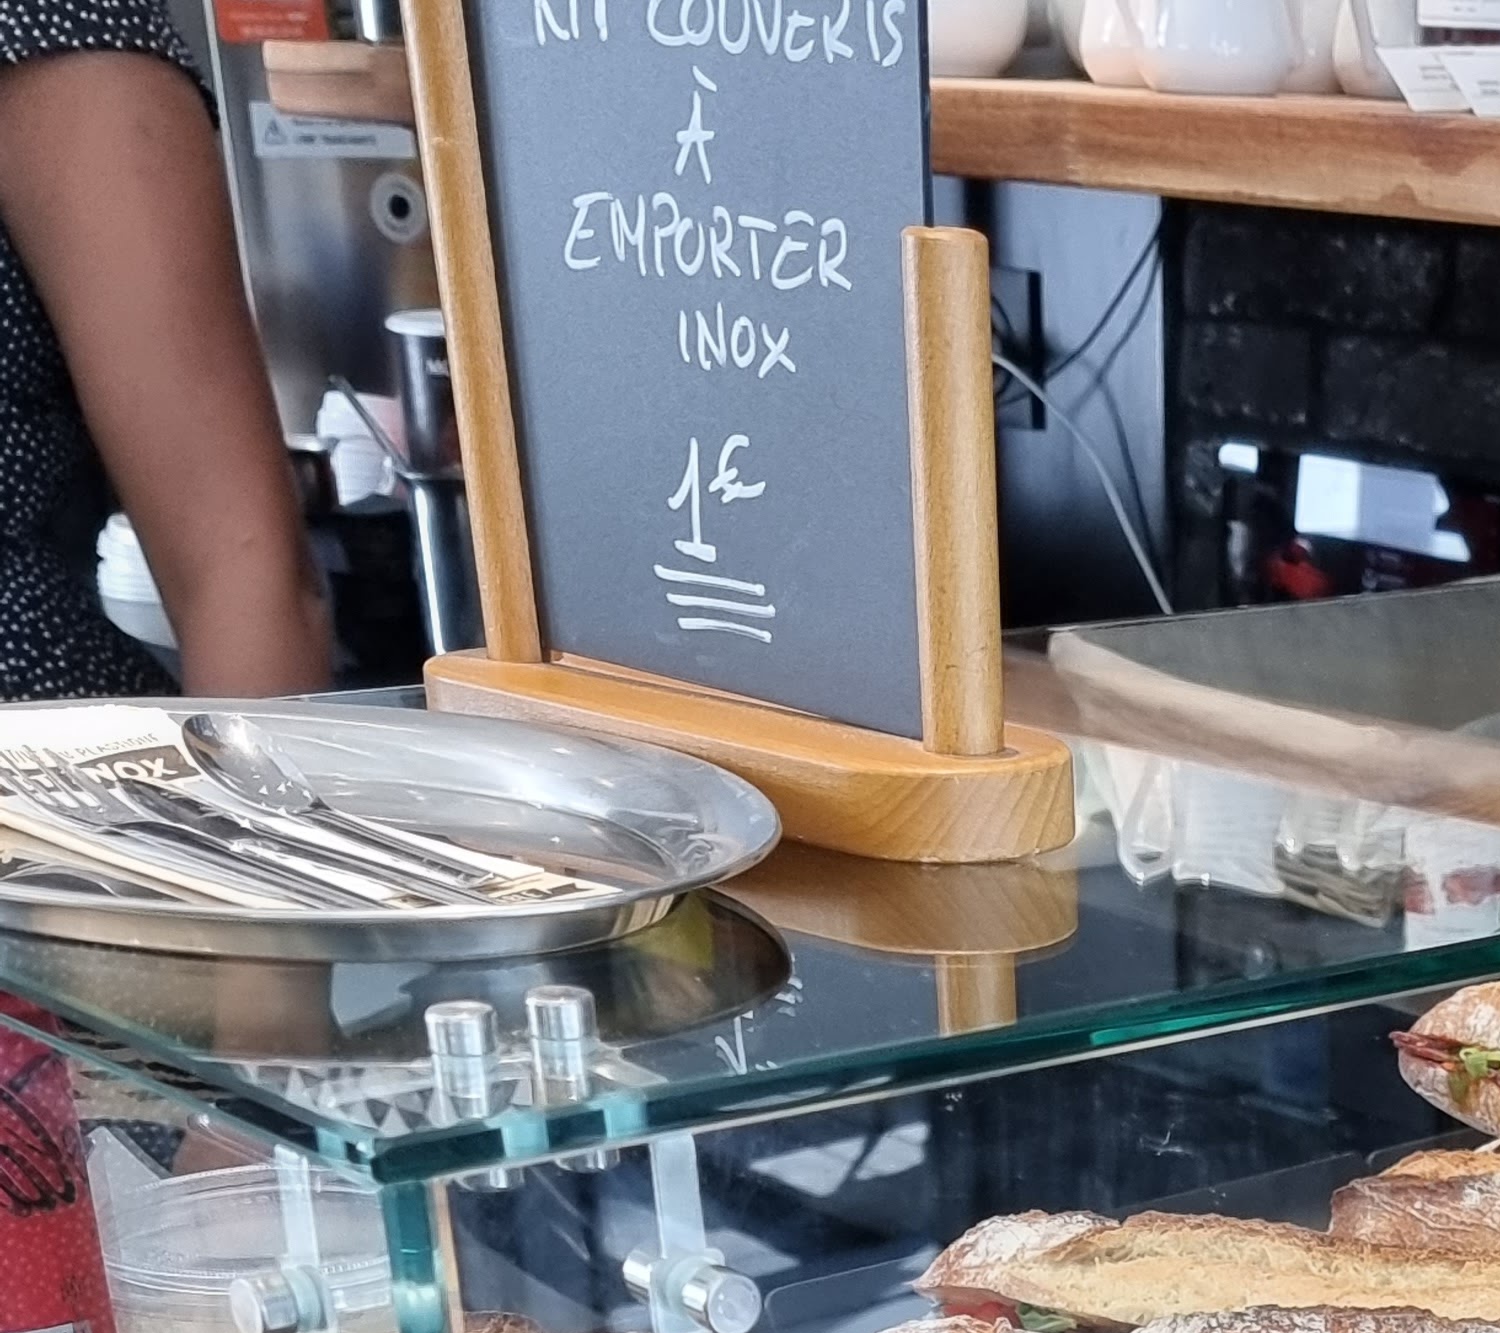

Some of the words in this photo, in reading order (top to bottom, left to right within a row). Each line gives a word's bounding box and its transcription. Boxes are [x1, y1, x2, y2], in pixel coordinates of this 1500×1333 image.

[674, 66, 717, 183] À
[564, 192, 852, 291] EMPORTER
[679, 303, 796, 378] INOX
